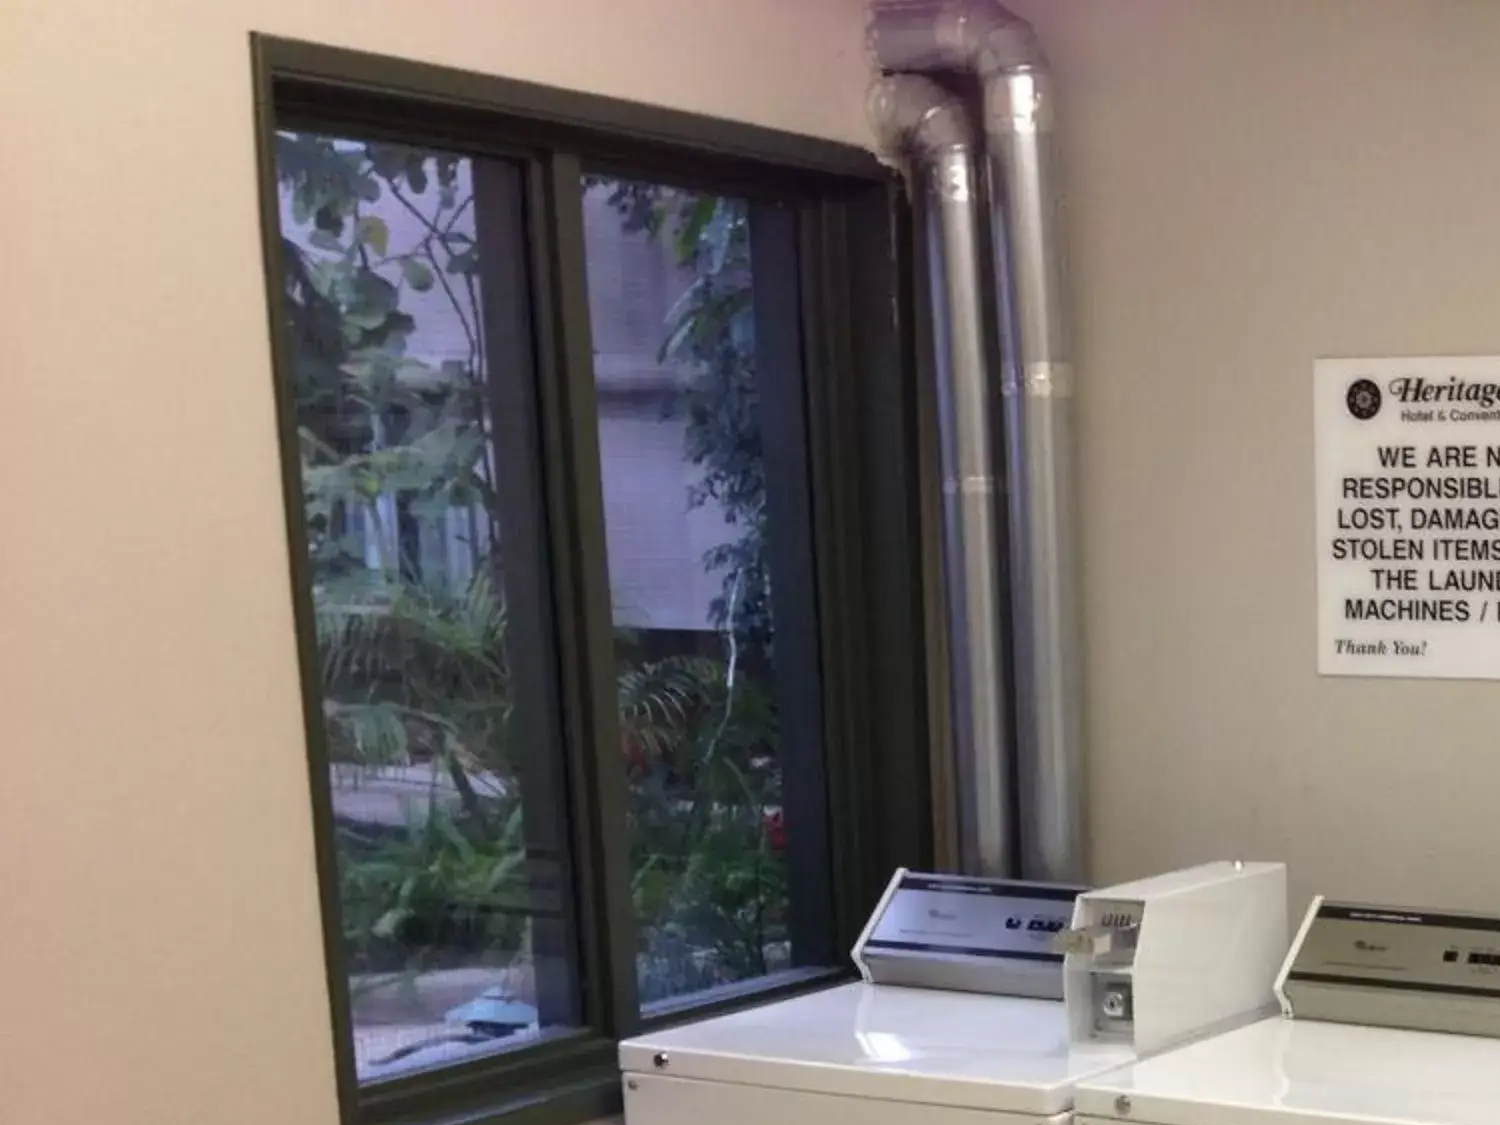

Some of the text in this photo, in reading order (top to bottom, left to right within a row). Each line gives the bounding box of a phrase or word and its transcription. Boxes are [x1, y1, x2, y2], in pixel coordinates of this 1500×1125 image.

[1401, 409, 1434, 422] Hotel
[1438, 409, 1446, 421] &
[1378, 446, 1416, 468] WE
[1427, 446, 1477, 468] ARE
[1337, 508, 1403, 533] LOST,
[1332, 539, 1423, 561] STOLEN
[1371, 569, 1417, 591] THE
[1344, 599, 1469, 622] MACHINES
[1480, 601, 1488, 623] /
[1335, 638, 1427, 656] Thank You!
